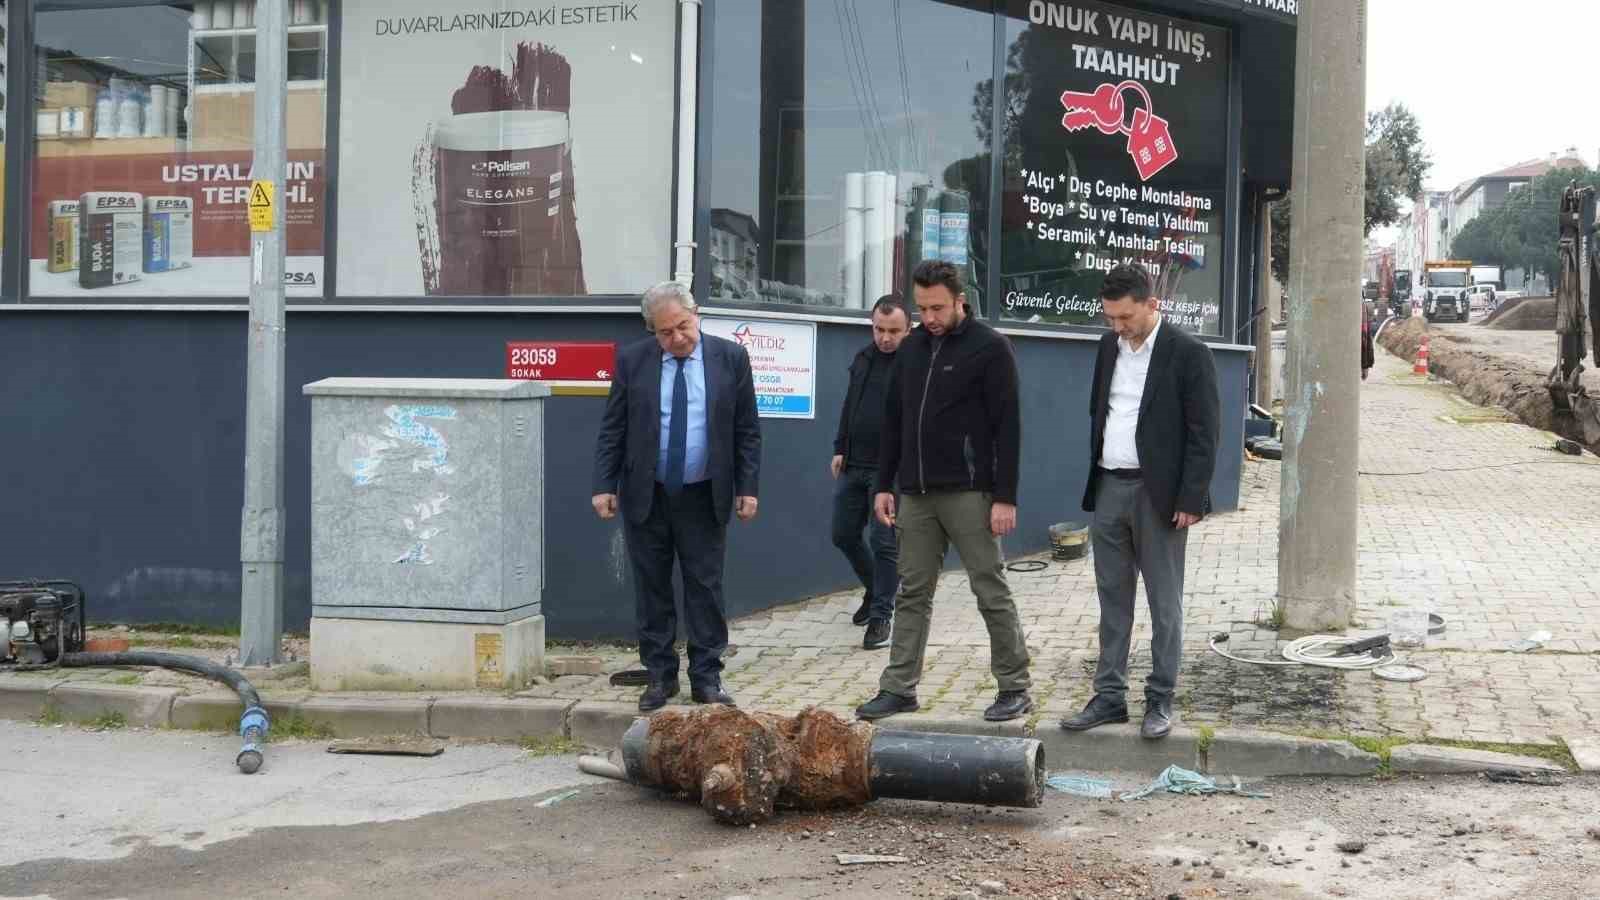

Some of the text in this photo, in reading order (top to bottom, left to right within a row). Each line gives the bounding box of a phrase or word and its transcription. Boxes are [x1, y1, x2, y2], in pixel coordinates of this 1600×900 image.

[375, 2, 639, 36] DUVARLARINIZDAKİ ESTETİK
[1029, 0, 1212, 63] ONUK YAPI İNŞ.
[1071, 43, 1181, 86] TAAHHÜT
[162, 160, 315, 182] USTALIN
[488, 160, 531, 172] Polisan
[96, 196, 137, 208] EPSA
[155, 200, 188, 208] EPSA
[201, 181, 315, 205] TERHİ.
[466, 186, 535, 199] ELEGANS
[1070, 176, 1092, 198] Dış
[1095, 180, 1138, 202] Cephe
[1141, 186, 1212, 211] Montalama
[1079, 203, 1097, 221] Su
[1101, 209, 1117, 222] ve
[1120, 207, 1160, 229] Temel
[1162, 212, 1210, 234] Yalıtımı
[1038, 223, 1097, 246] Seramik
[1164, 236, 1205, 258] Teslim
[92, 241, 103, 272] BUDA
[284, 271, 316, 284] PSA
[1006, 291, 1053, 311] Güvenle
[511, 368, 542, 378] SOKAK
